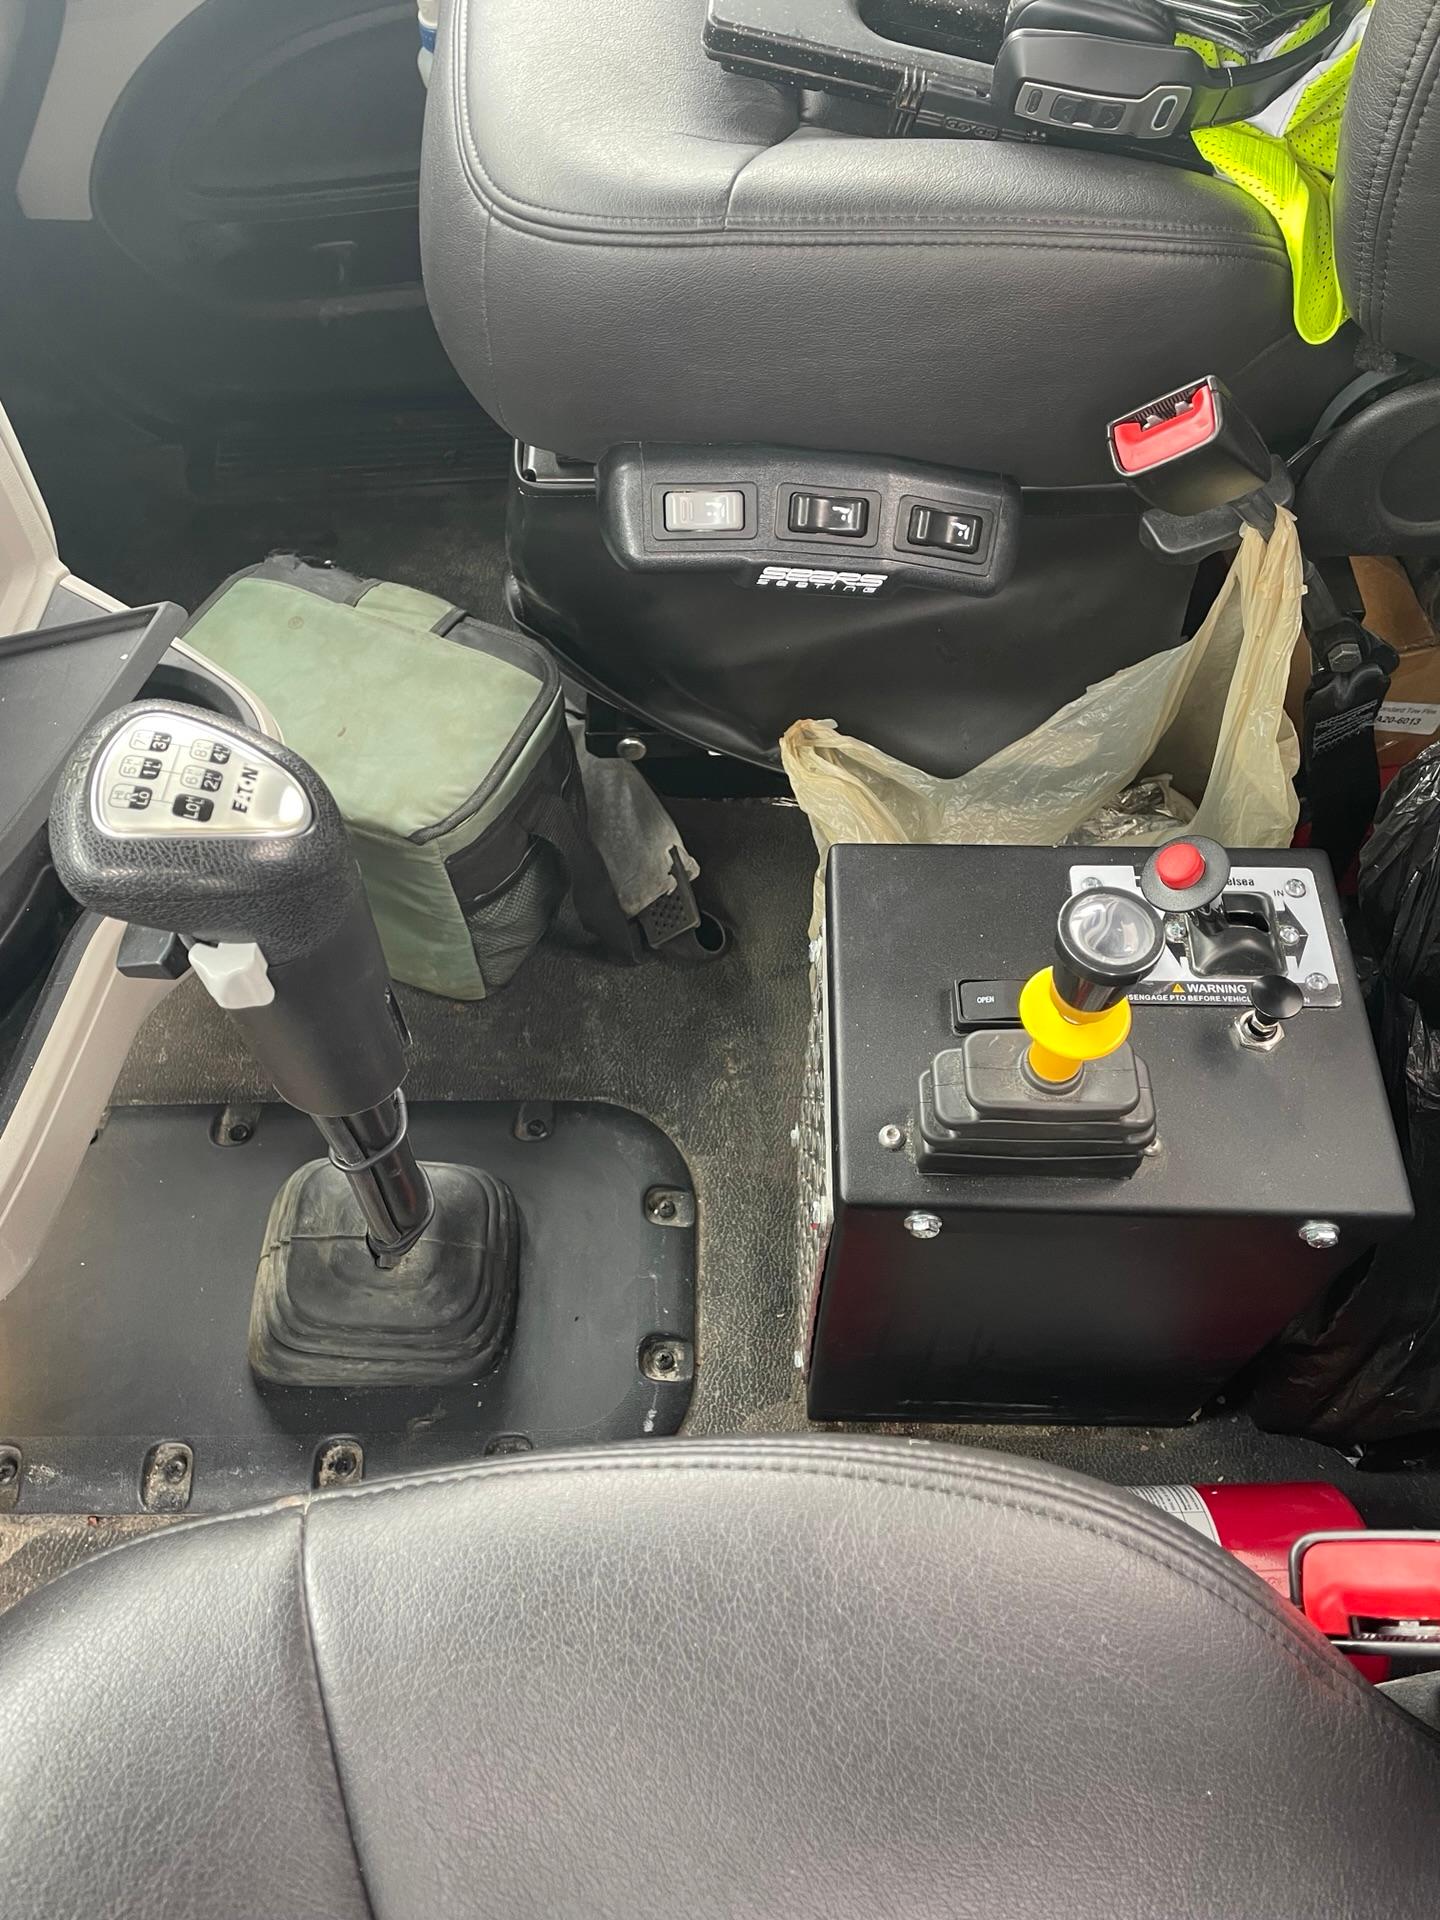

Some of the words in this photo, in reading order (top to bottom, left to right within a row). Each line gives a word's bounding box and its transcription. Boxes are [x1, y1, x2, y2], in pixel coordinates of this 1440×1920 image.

[760, 566, 888, 587] SEARS
[1226, 877, 1255, 886] elsea
[1273, 889, 1284, 897] IN
[1187, 983, 1248, 994] WARNING
[976, 995, 995, 1004] OPEN
[1188, 994, 1221, 1003] BEFORE
[1222, 995, 1251, 1003] VEHICL
